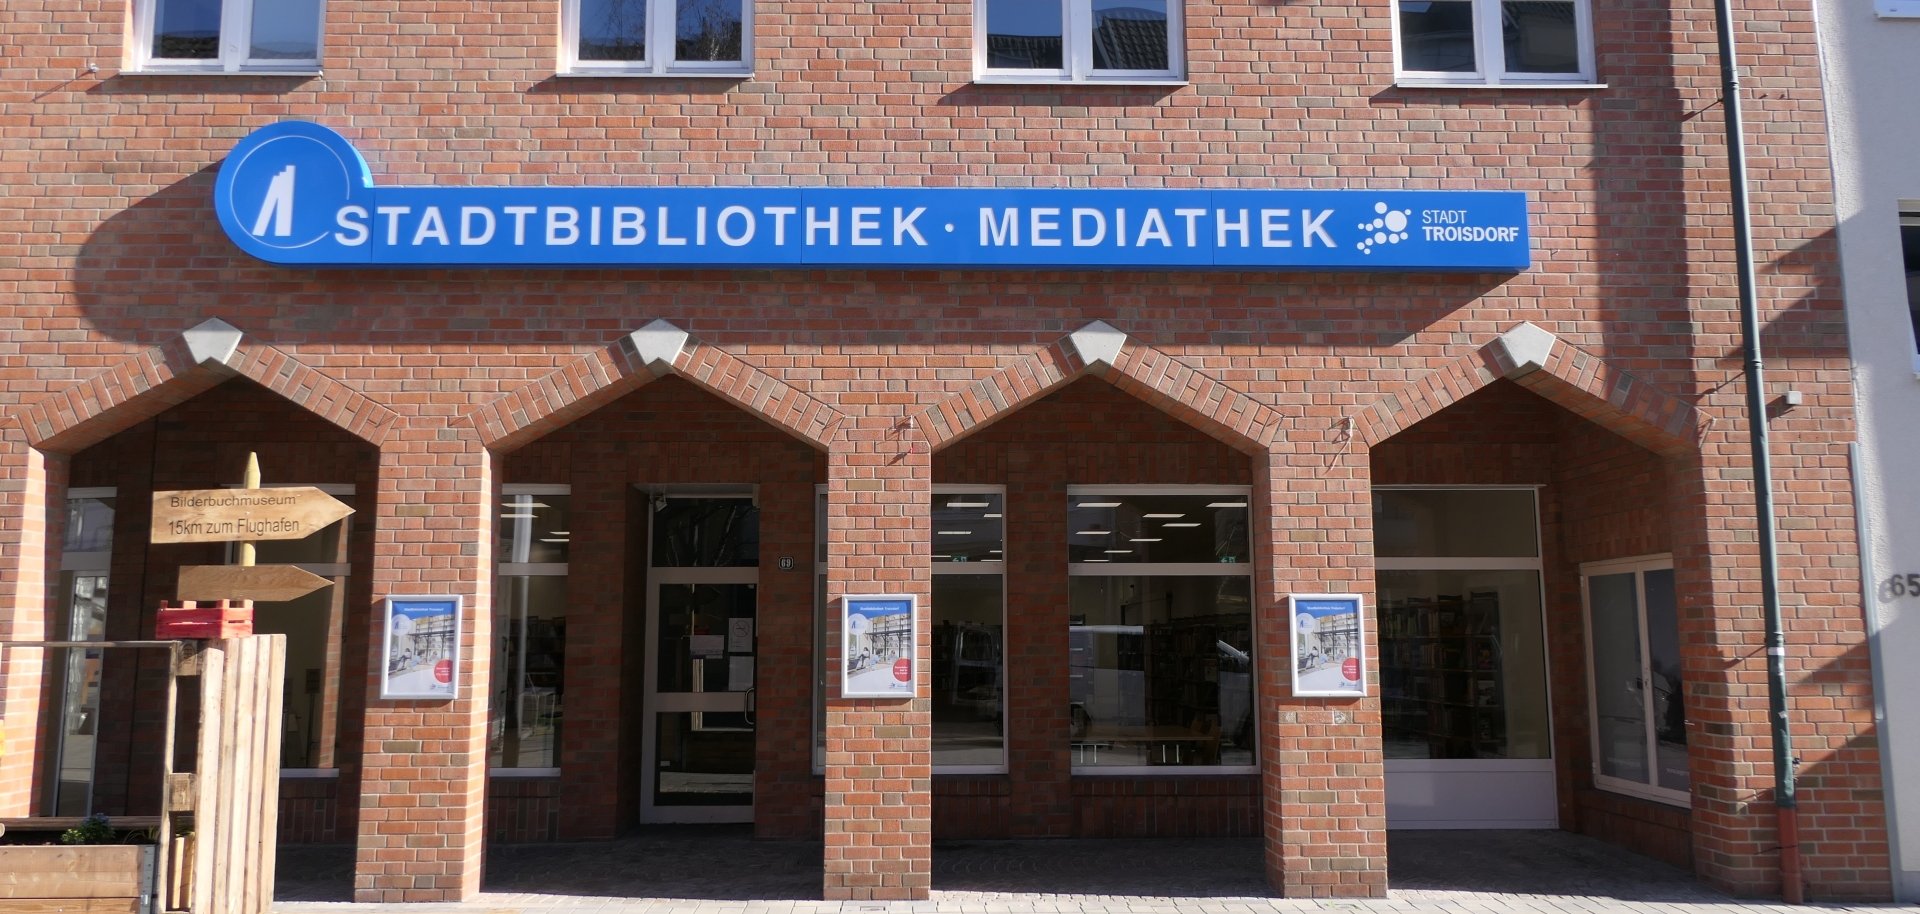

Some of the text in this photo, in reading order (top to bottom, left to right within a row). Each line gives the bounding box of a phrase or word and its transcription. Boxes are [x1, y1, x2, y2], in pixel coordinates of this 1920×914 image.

[1422, 209, 1467, 224] STADT
[334, 205, 928, 248] STADTBIBLIOTHEK
[978, 206, 1337, 249] MEDIATHEK
[1422, 226, 1519, 242] TROISDORF
[170, 495, 296, 508] Bilderbuchmuseum
[168, 518, 299, 536] 15km zum Flughafen
[781, 557, 792, 568] 69
[1891, 573, 1920, 597] 65
